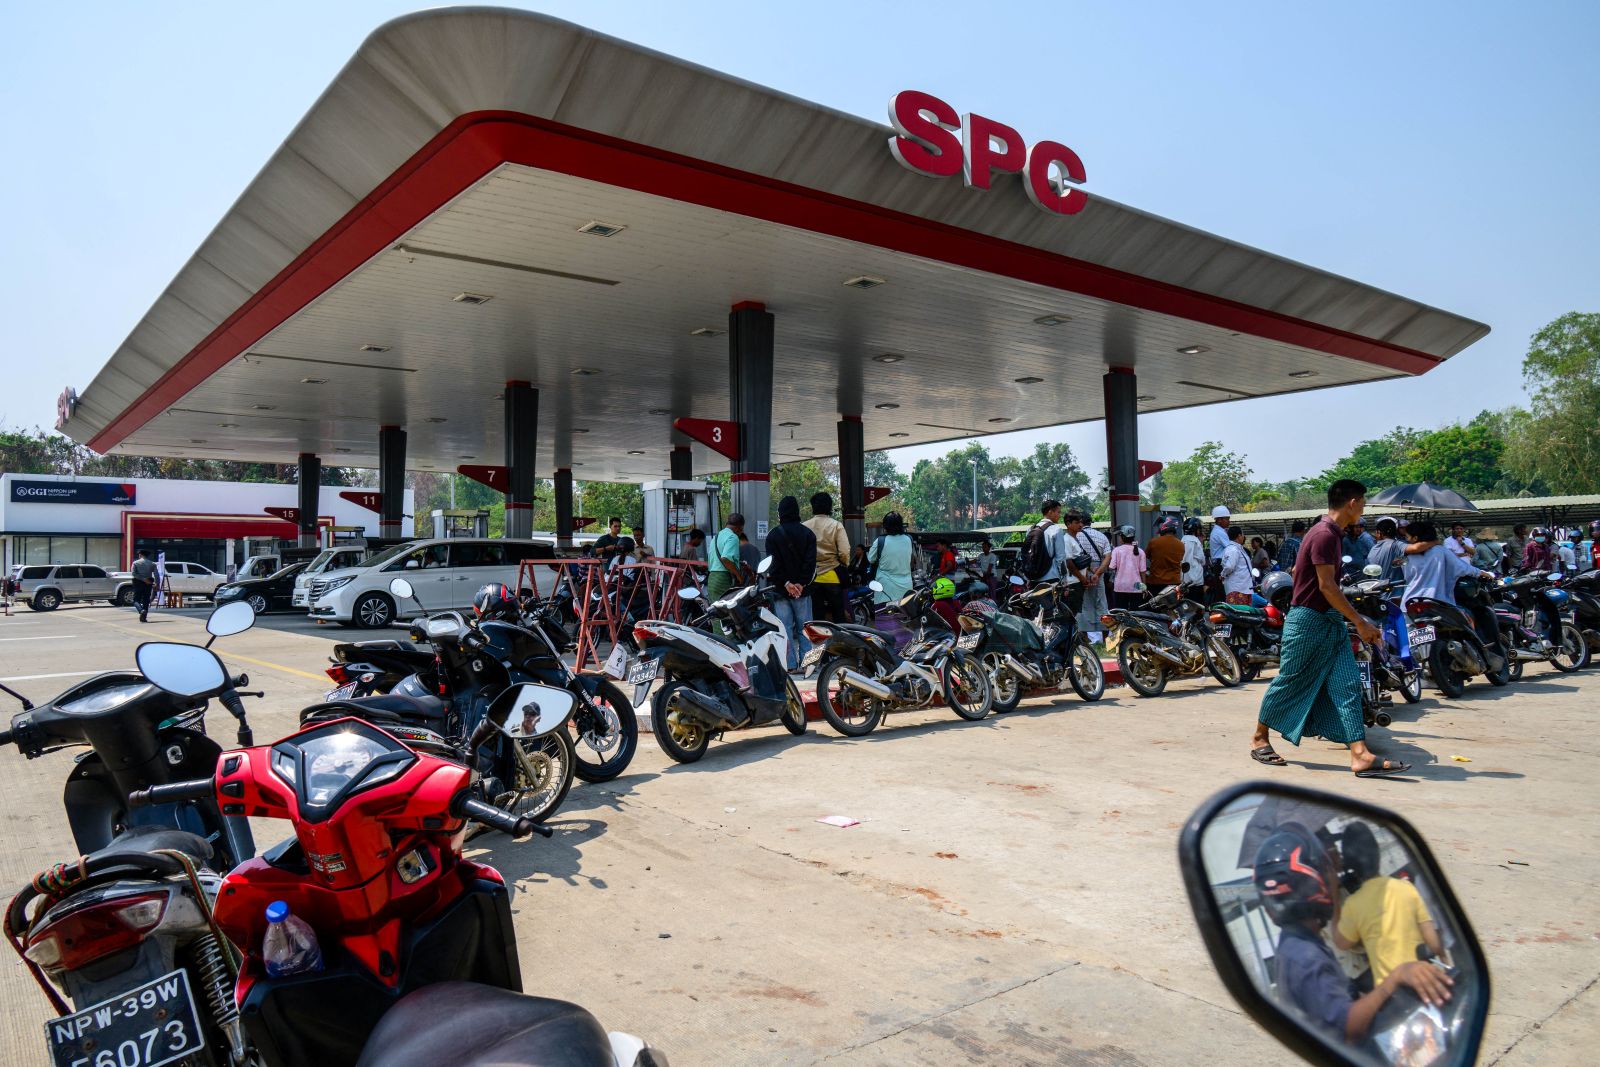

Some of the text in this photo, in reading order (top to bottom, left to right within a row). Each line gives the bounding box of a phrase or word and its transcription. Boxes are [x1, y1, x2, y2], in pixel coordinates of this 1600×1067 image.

[888, 90, 1088, 216] SPC
[712, 426, 722, 443] 3
[487, 470, 496, 482] 7
[1141, 464, 1146, 477] 1
[27, 487, 47, 496] GGI
[869, 490, 875, 500] 5
[362, 495, 375, 505] 11
[282, 510, 294, 518] 15
[575, 519, 585, 527] 13
[630, 669, 656, 683] 43342
[55, 977, 178, 1044] NPW-39W
[71, 1019, 188, 1067] 6073
